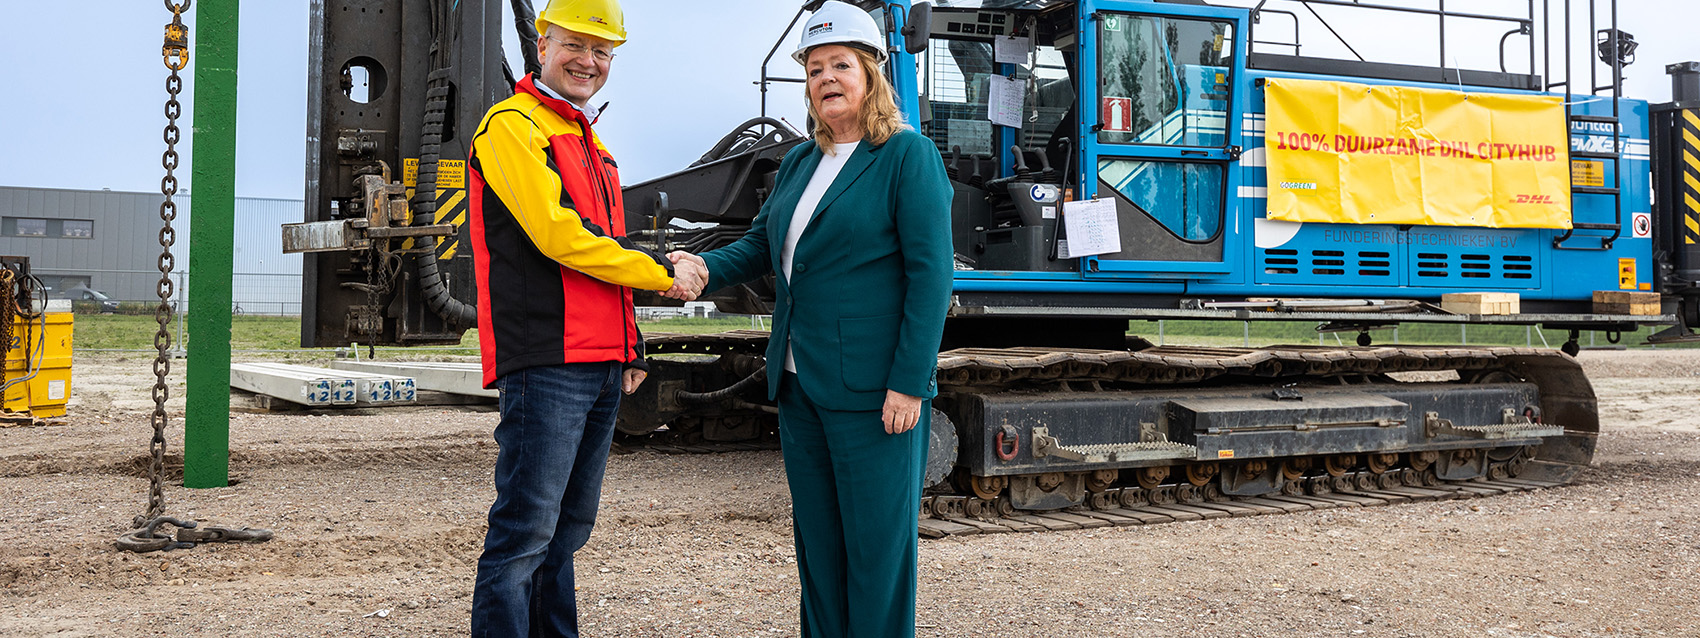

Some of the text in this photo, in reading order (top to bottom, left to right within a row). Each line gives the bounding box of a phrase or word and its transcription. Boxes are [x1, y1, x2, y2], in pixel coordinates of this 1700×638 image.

[1277, 131, 1556, 162] 100% DUURZAME DHL CITYHUB
[1516, 194, 1553, 204] DHL
[1325, 229, 1517, 248] FUNDERINGSTECHNIEKEN BV
